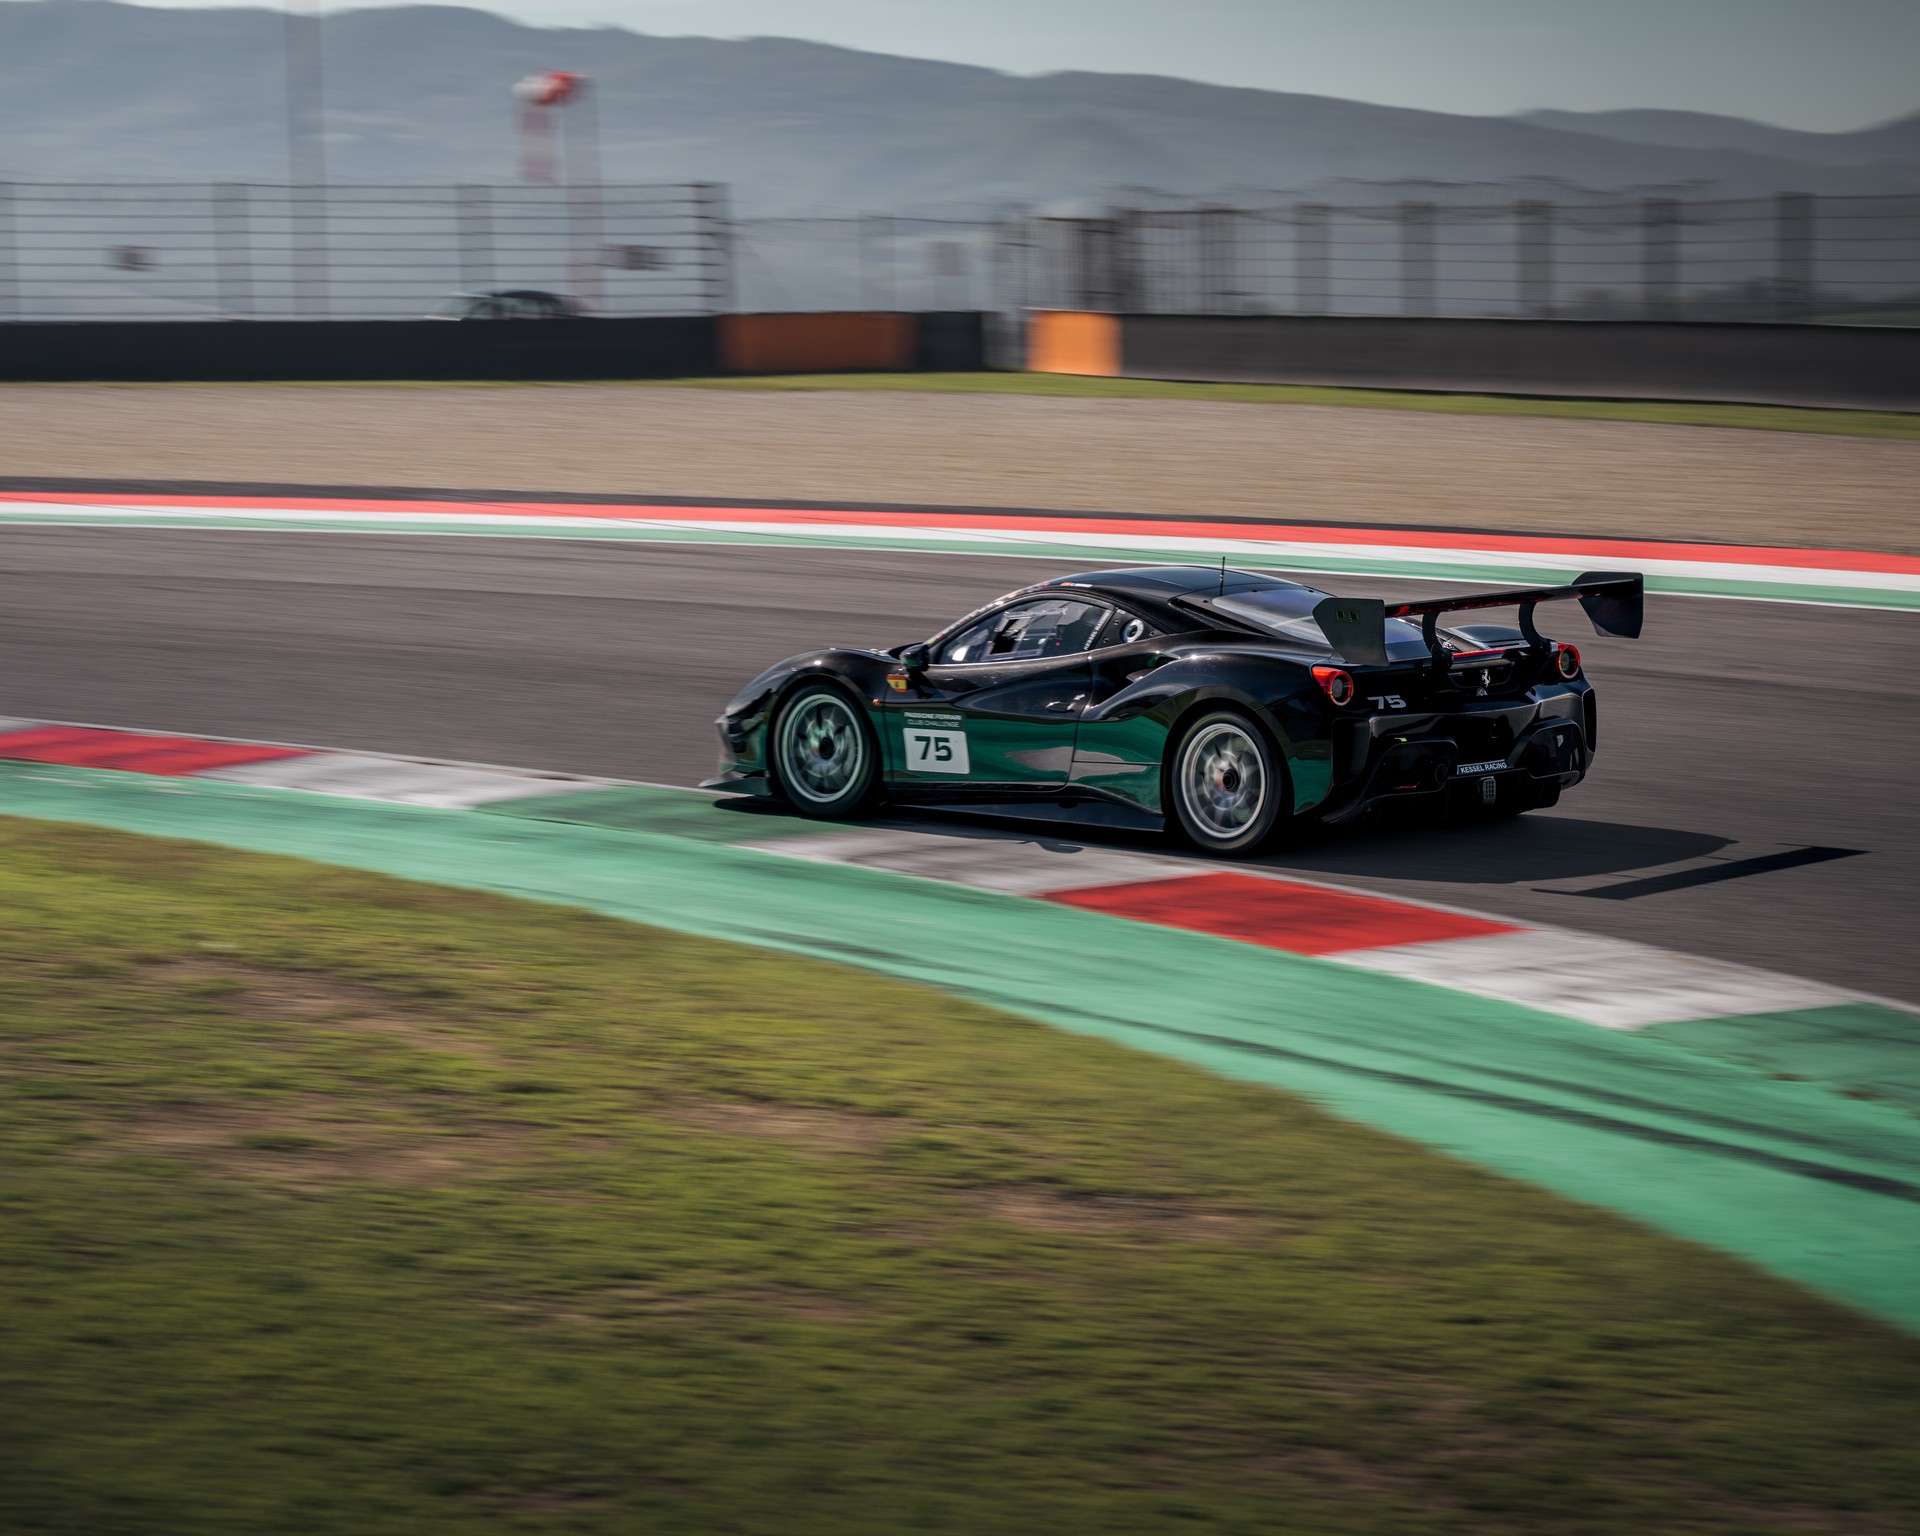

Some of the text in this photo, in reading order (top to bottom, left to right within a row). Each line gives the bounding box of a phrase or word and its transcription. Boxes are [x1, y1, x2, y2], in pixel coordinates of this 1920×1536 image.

[1366, 695, 1407, 709] 75
[914, 736, 952, 761] 75
[1460, 762, 1507, 773] KESSEL RACING
